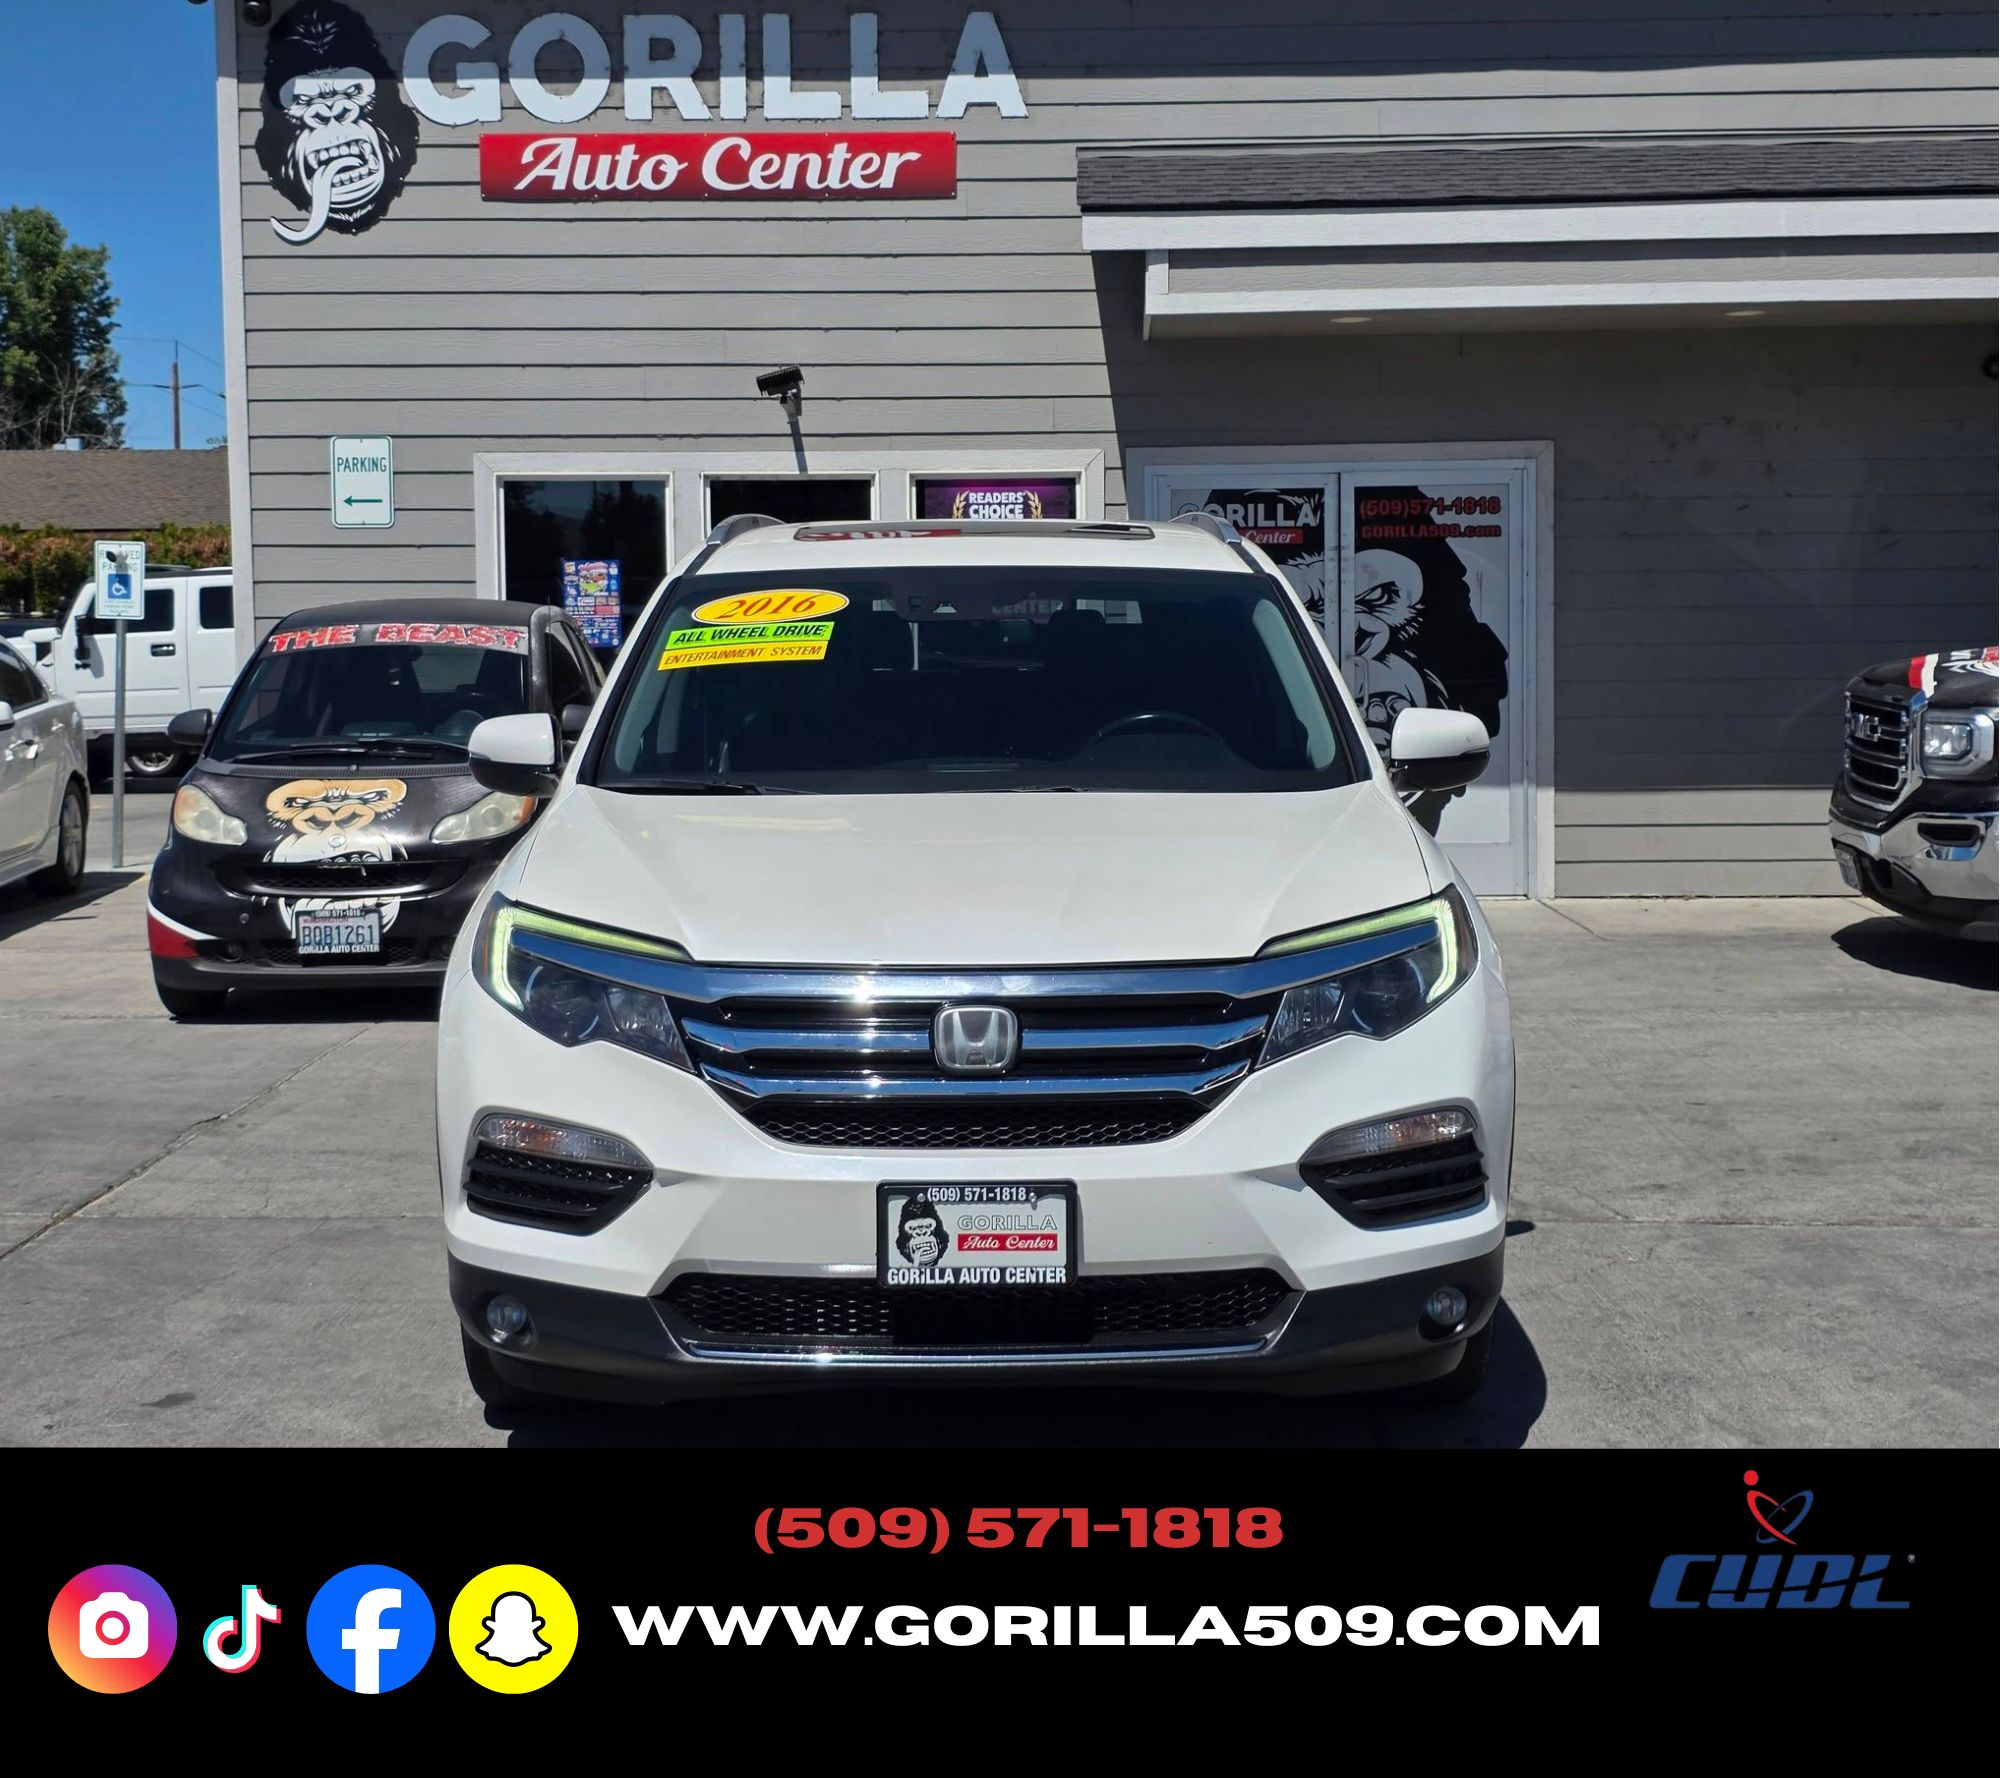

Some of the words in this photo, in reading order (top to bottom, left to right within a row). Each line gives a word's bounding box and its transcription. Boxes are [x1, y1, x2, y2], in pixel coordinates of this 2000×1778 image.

[402, 11, 1029, 127] GORILLA
[514, 136, 689, 191] Auto
[702, 136, 922, 191] Center
[337, 456, 387, 473] PARKING
[968, 491, 1026, 504] READERS'
[968, 504, 1024, 519] CHOICE
[1359, 496, 1502, 520] (509)571-1818
[1361, 523, 1502, 539] GORILLA509.com
[714, 595, 825, 620] 2016
[269, 624, 359, 653] THE
[374, 623, 528, 649] BEAST
[674, 631, 704, 644] ALL
[710, 627, 768, 640] WHEEL
[773, 624, 829, 637] DRIVE
[665, 648, 764, 665] ENTERTAINMENT
[770, 646, 822, 657] SYSTEM
[351, 945, 379, 953] CENTER
[927, 1188, 960, 1202] (509)
[964, 1187, 1026, 1201] 571-1818
[957, 1215, 1057, 1230] GORILLA
[962, 1236, 1000, 1249] Auto
[1006, 1235, 1055, 1249] Center
[959, 1268, 1001, 1284] AUTO
[1005, 1267, 1066, 1284] CENTER
